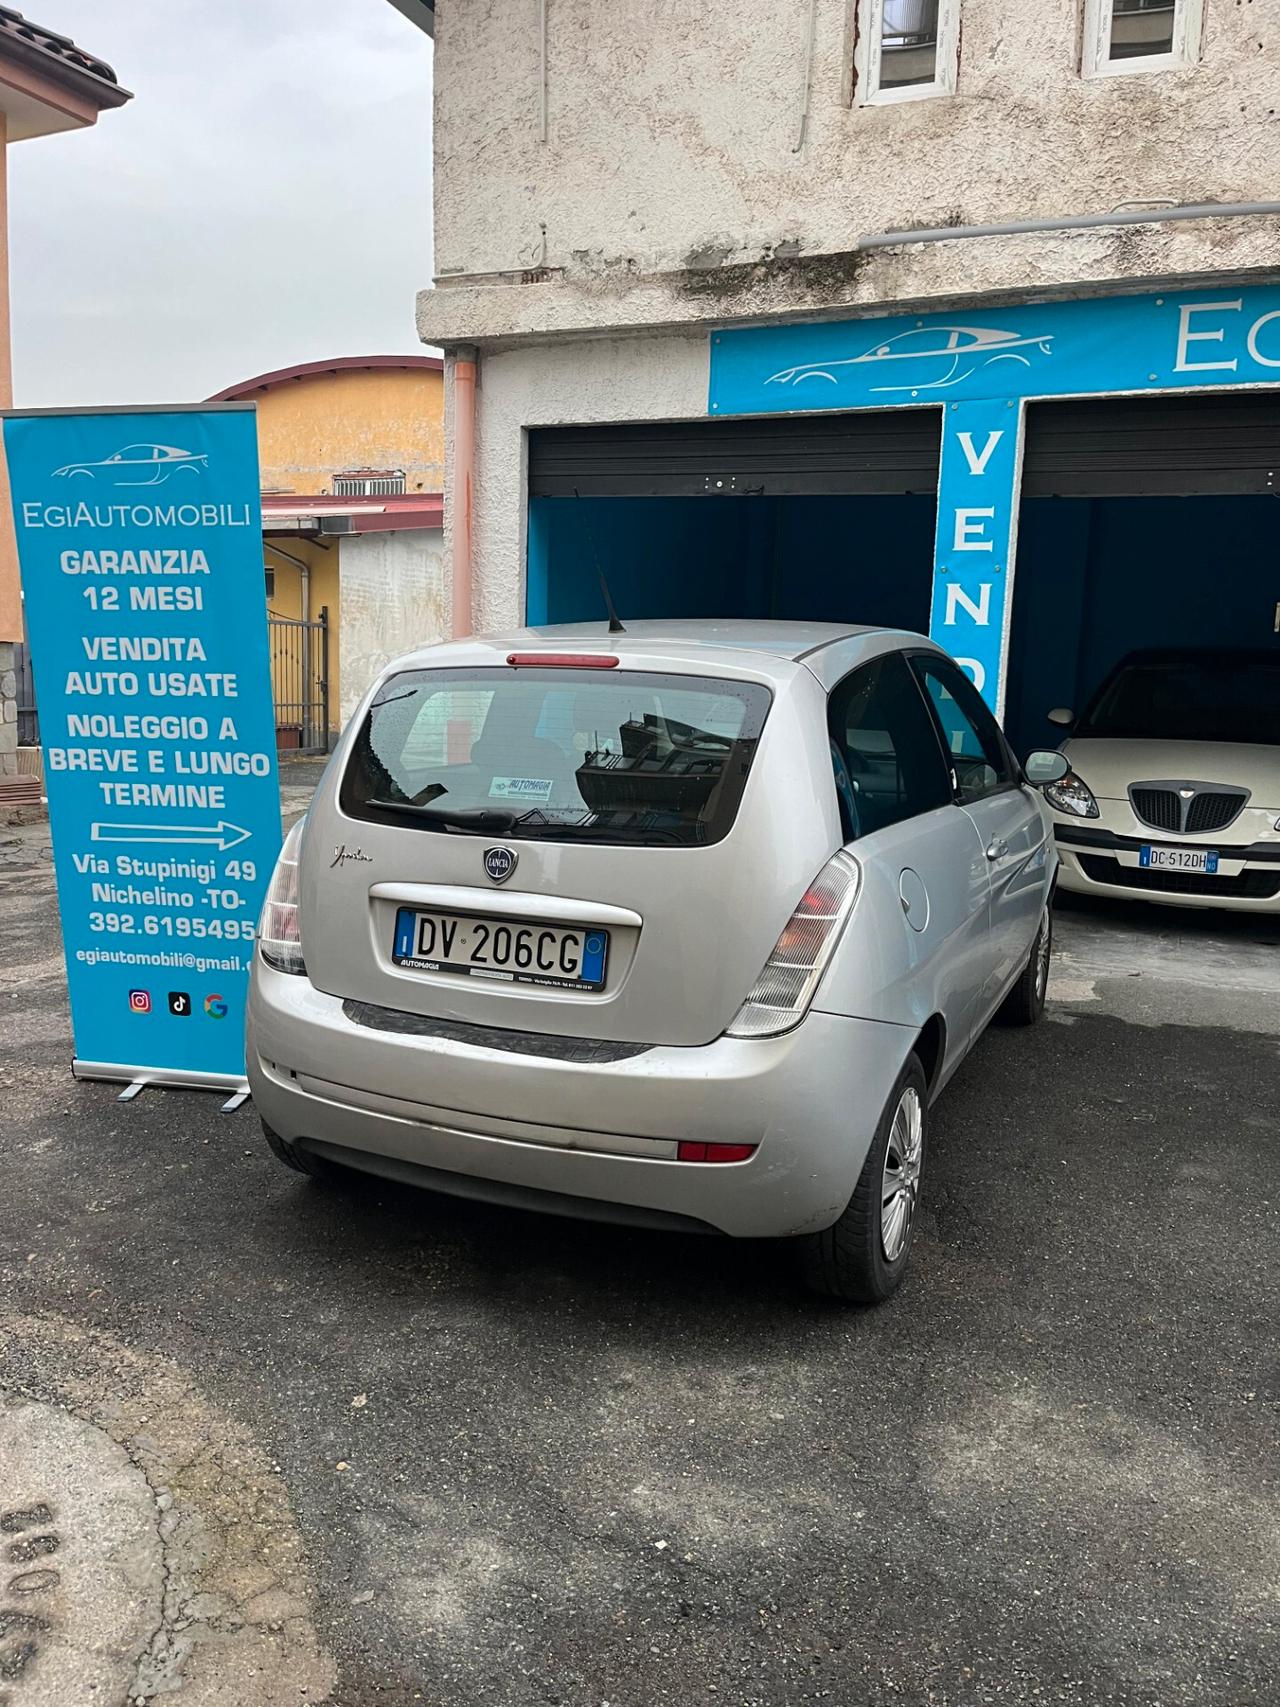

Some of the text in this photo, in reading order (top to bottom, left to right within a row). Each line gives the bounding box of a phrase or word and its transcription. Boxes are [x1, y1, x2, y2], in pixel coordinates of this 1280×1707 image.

[61, 550, 210, 574] GARANZIA
[84, 587, 202, 610] 12 MESI
[82, 638, 206, 660] VENDITA
[66, 672, 237, 696] AUTO USATE
[68, 715, 237, 740] NOLEGGIO A
[49, 748, 269, 776] BREVE E LUNGO
[100, 783, 225, 808] TERMINE
[508, 779, 551, 792] AUTOMAGIA
[73, 854, 255, 884] Via Stupinigi 49
[487, 856, 509, 868] LANCIA
[1151, 850, 1166, 865] DC
[1169, 852, 1206, 868] 512DH
[92, 883, 245, 909] Nichelino -TO-
[89, 912, 256, 941] 392.6195495
[417, 916, 458, 958] DV
[470, 923, 580, 974] 206CG
[400, 959, 440, 970] AUTOMAGIA
